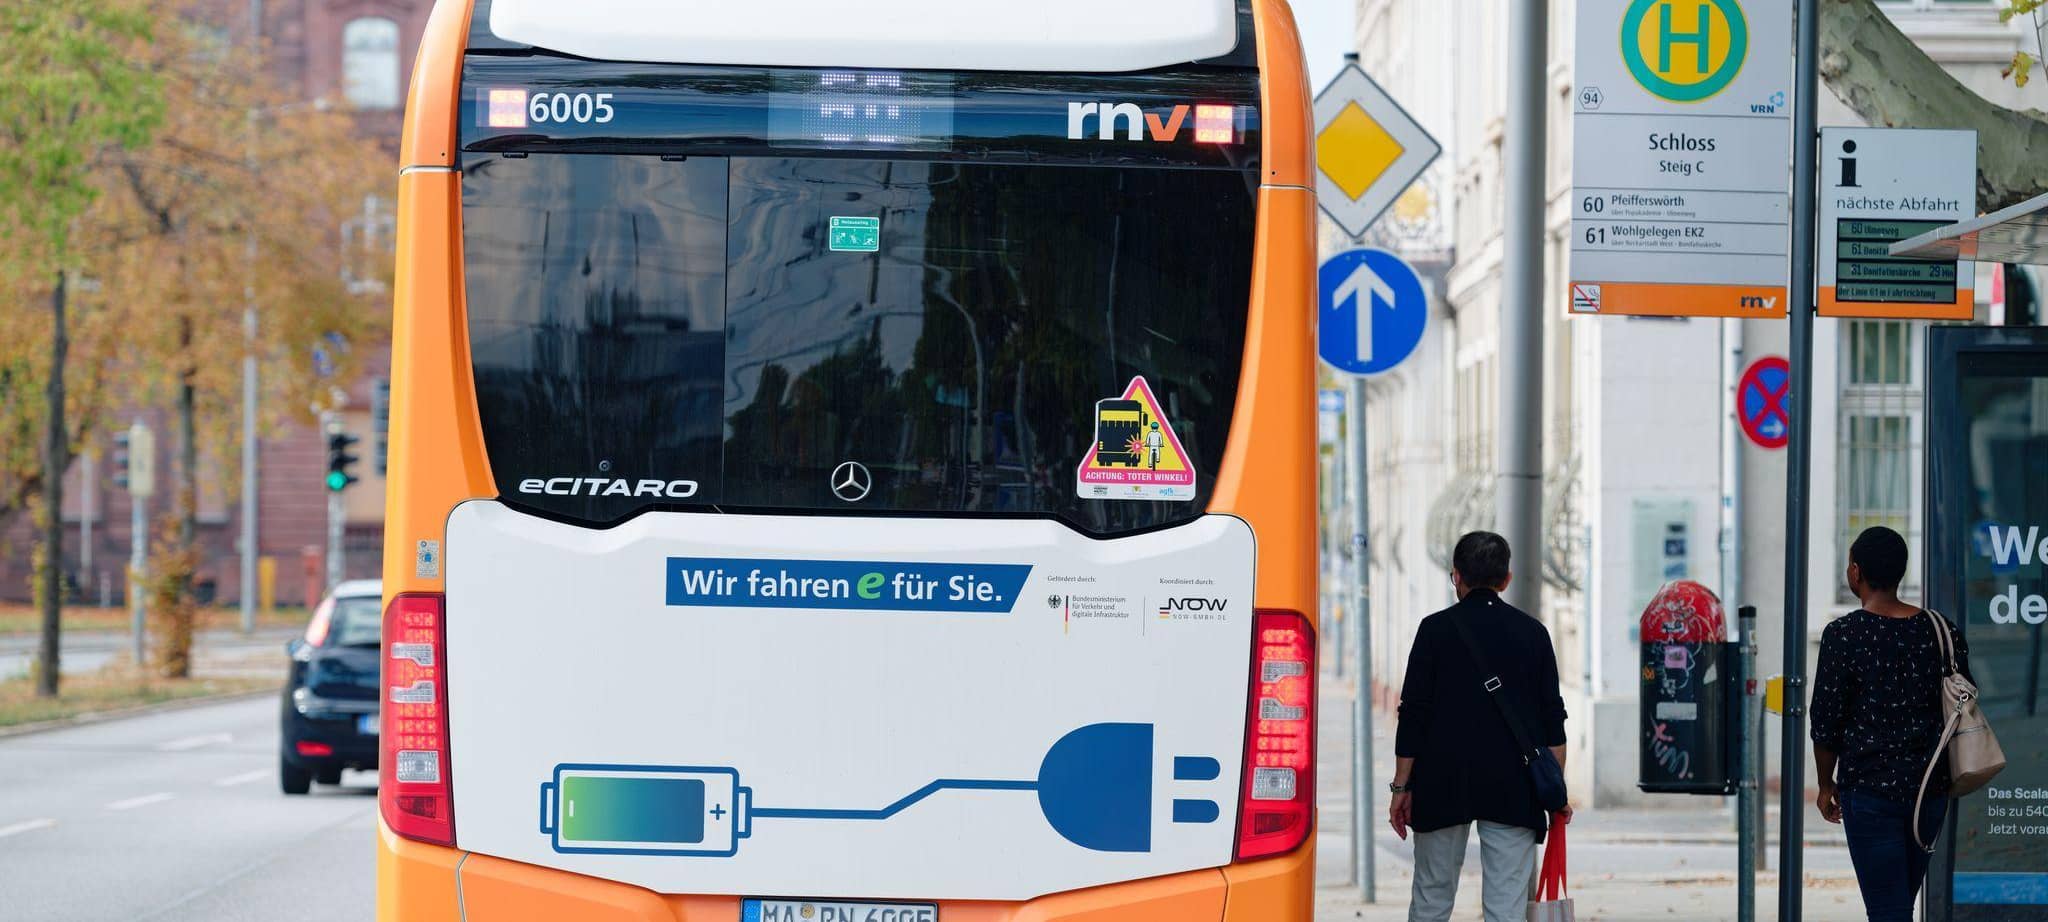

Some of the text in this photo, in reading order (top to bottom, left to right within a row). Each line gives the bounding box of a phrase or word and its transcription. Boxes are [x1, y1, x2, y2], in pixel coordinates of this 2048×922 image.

[1659, 3, 1710, 73] H
[1583, 92, 1598, 105] 94
[529, 92, 614, 123] 6005
[1750, 104, 1775, 113] VRN
[1067, 102, 1190, 141] rnv
[1648, 132, 1716, 152] Schloss
[1659, 160, 1705, 176] Steig C
[1583, 194, 1685, 213] 60 Pfeifferswörth
[1836, 196, 1960, 211] nächste Abfahrt
[1585, 226, 1705, 244] 61 Wohlgelegen EKZ
[1851, 223, 1863, 234] 60
[1851, 243, 1861, 255] 61
[1740, 295, 1777, 309] rnv
[1085, 471, 1188, 482] ACHTUNG: TOTER WINKEL!
[518, 477, 698, 498] eCITARO
[682, 569, 1002, 602] Wir fahren e für Sie.
[1162, 597, 1228, 611] NOW
[1989, 584, 2048, 624] de
[1988, 787, 2048, 799] Das Scala
[1988, 805, 2006, 817] bis
[2008, 807, 2023, 817] zu
[1987, 823, 2048, 835] Jetzt vora
